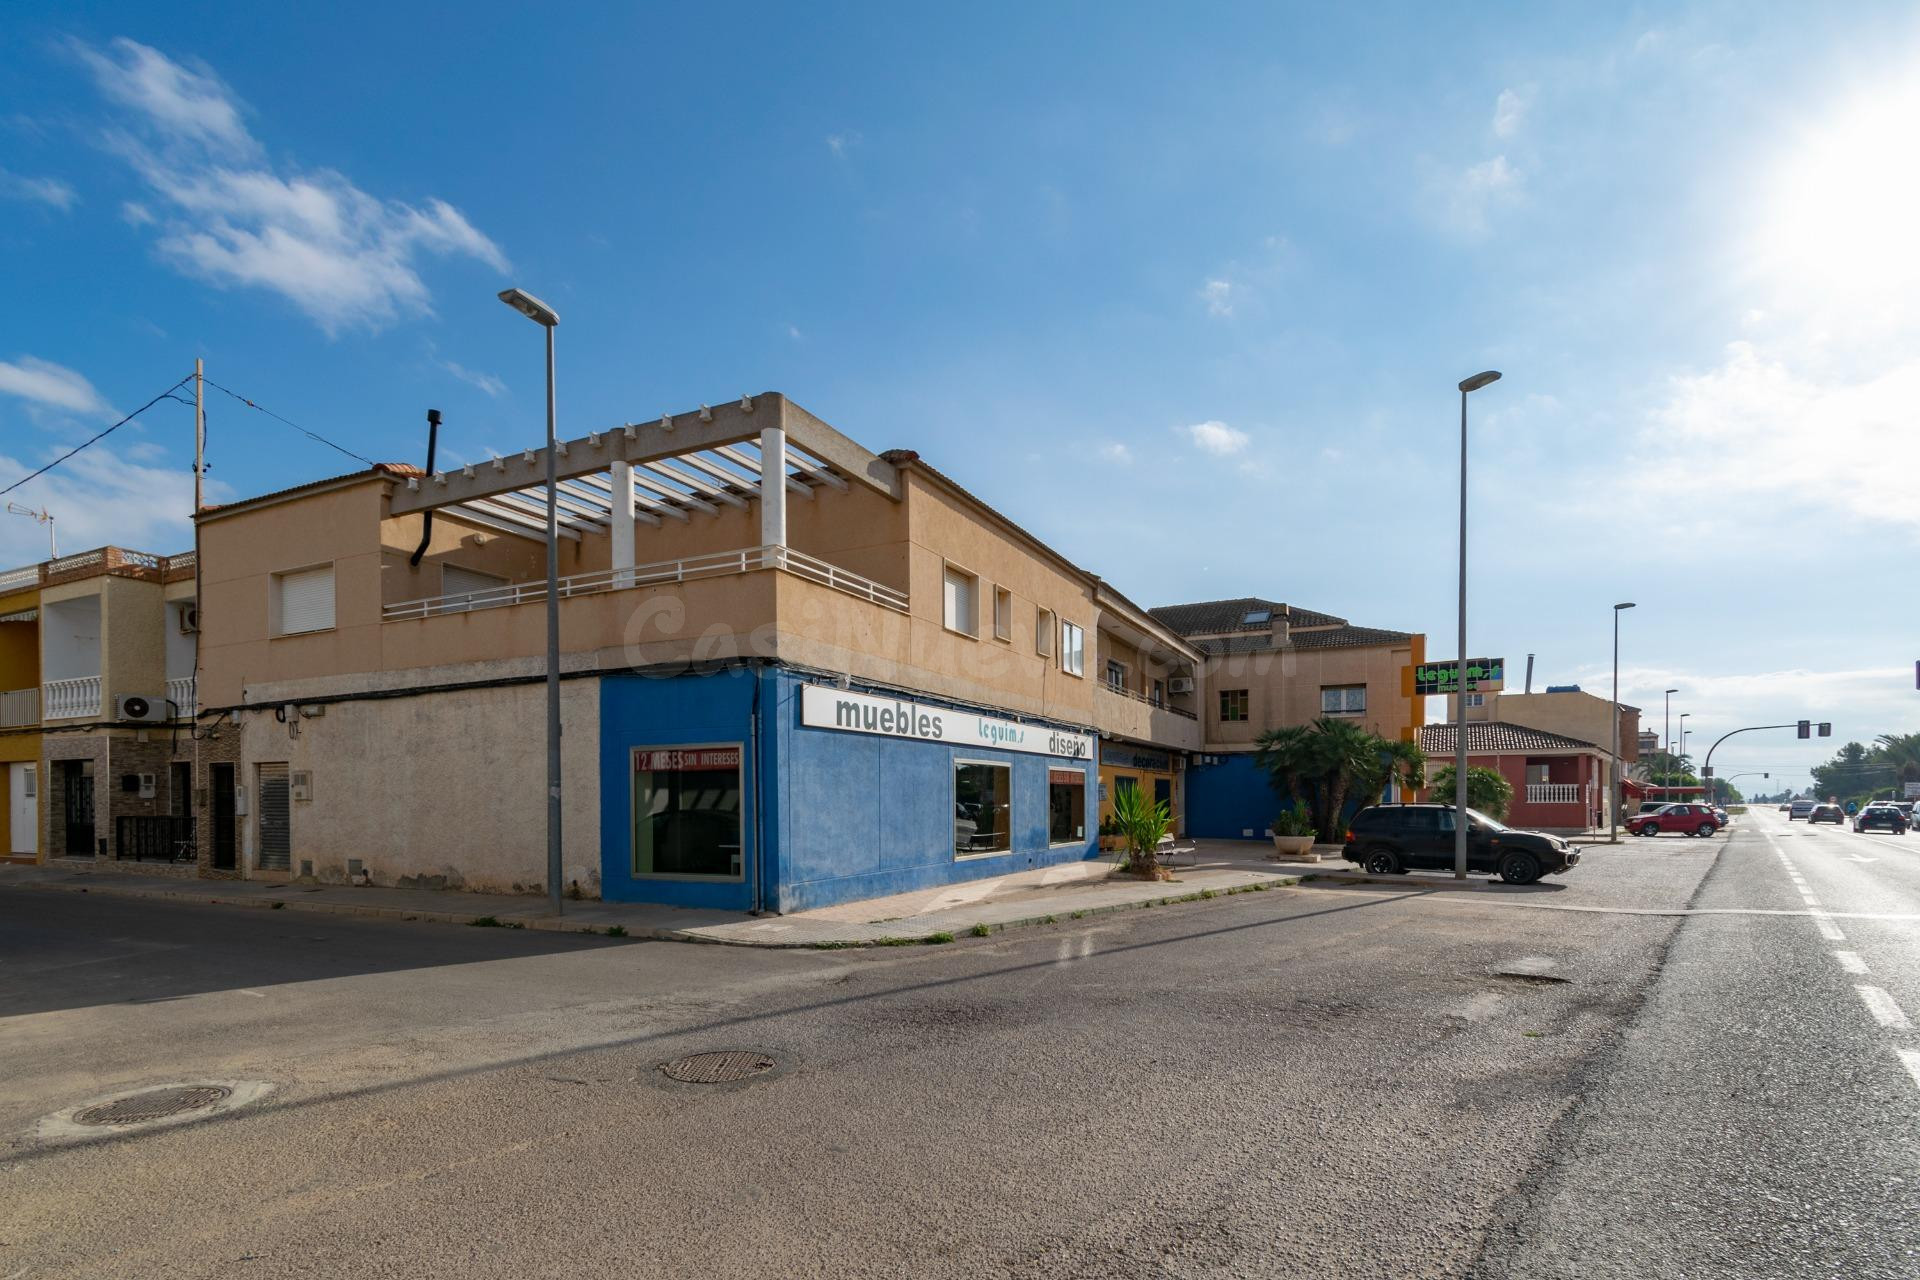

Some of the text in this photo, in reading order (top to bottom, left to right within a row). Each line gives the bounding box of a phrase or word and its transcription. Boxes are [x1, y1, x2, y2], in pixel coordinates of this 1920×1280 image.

[836, 700, 943, 739] muebles
[1049, 731, 1086, 757] diseño
[651, 750, 684, 770] MESES
[684, 753, 697, 767] SIN
[701, 751, 739, 766] INTERESES
